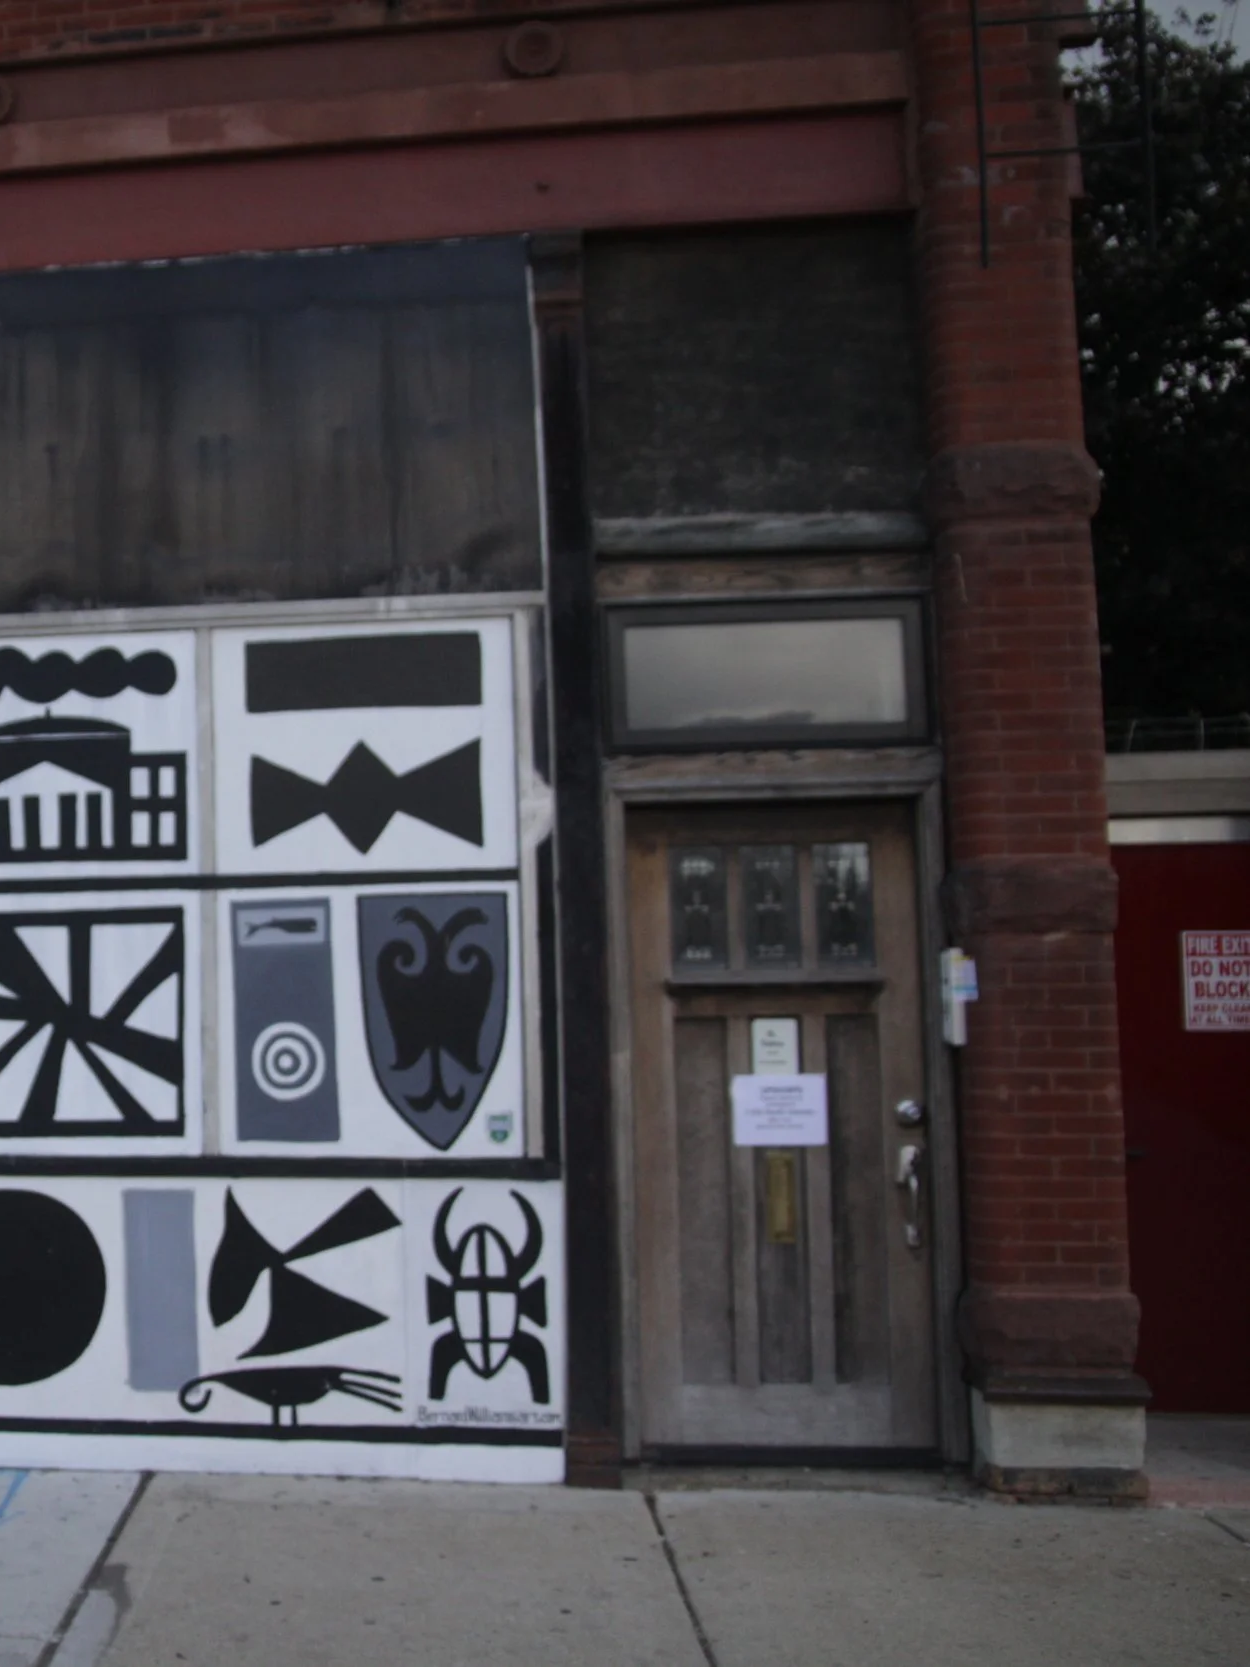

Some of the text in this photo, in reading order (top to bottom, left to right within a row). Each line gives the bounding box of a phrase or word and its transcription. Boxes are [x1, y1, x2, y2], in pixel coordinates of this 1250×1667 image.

[1188, 936, 1217, 953] FIRE
[1191, 960, 1250, 977] DO NOT
[1195, 980, 1250, 998] BLOCK
